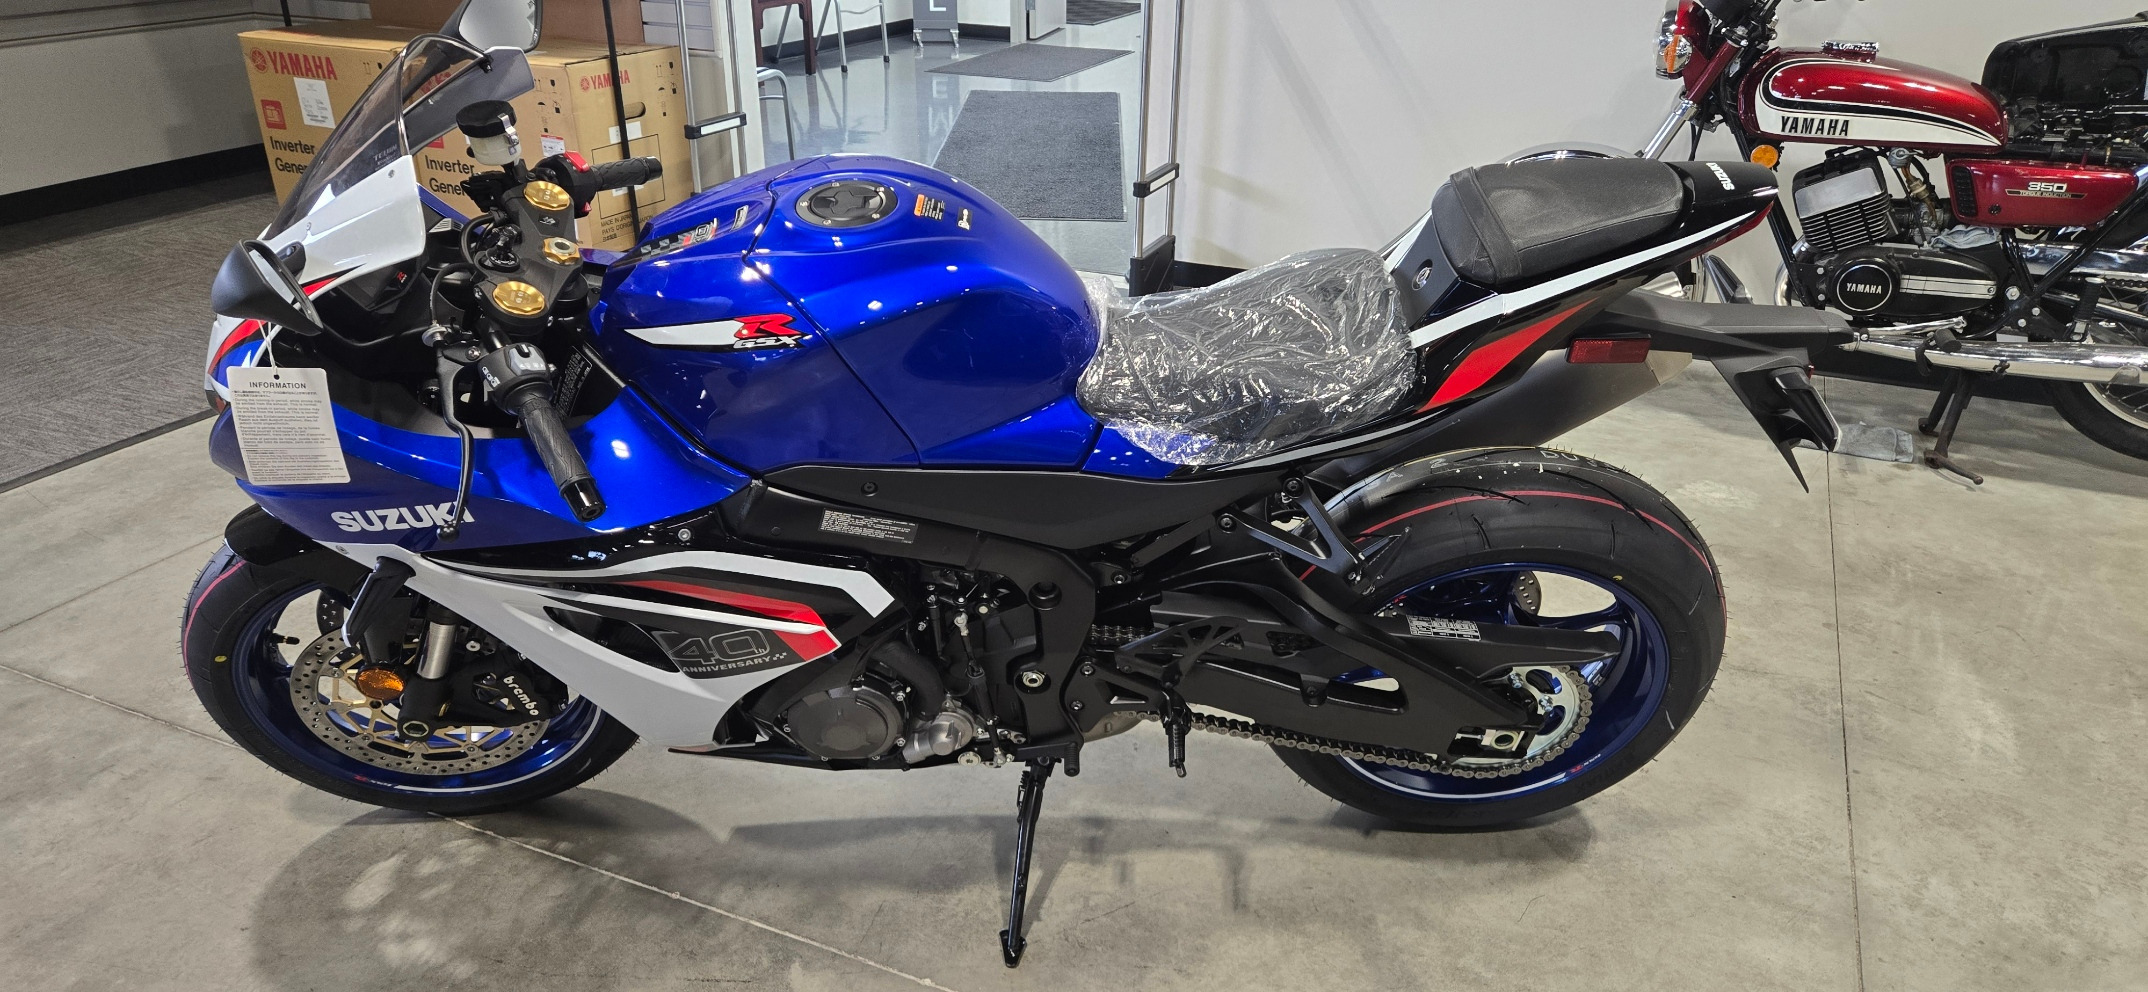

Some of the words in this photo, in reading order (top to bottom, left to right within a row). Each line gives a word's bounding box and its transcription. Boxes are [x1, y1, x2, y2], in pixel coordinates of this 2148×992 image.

[266, 50, 338, 80] YAMAHA
[590, 69, 631, 90] YAMHA
[1781, 116, 1850, 136] YAMAHA
[270, 136, 315, 155] Inverter
[425, 155, 475, 174] Inverter
[1706, 162, 1735, 190] SUZUKI
[2027, 181, 2068, 193] 350
[1847, 282, 1882, 294] YAMAHA
[733, 313, 802, 339] R
[733, 335, 802, 349] GSX
[249, 381, 307, 389] INFORMATION
[330, 501, 475, 532] SUZUKI
[682, 655, 771, 673] ANNIVERSARY
[503, 675, 539, 716] brembo
